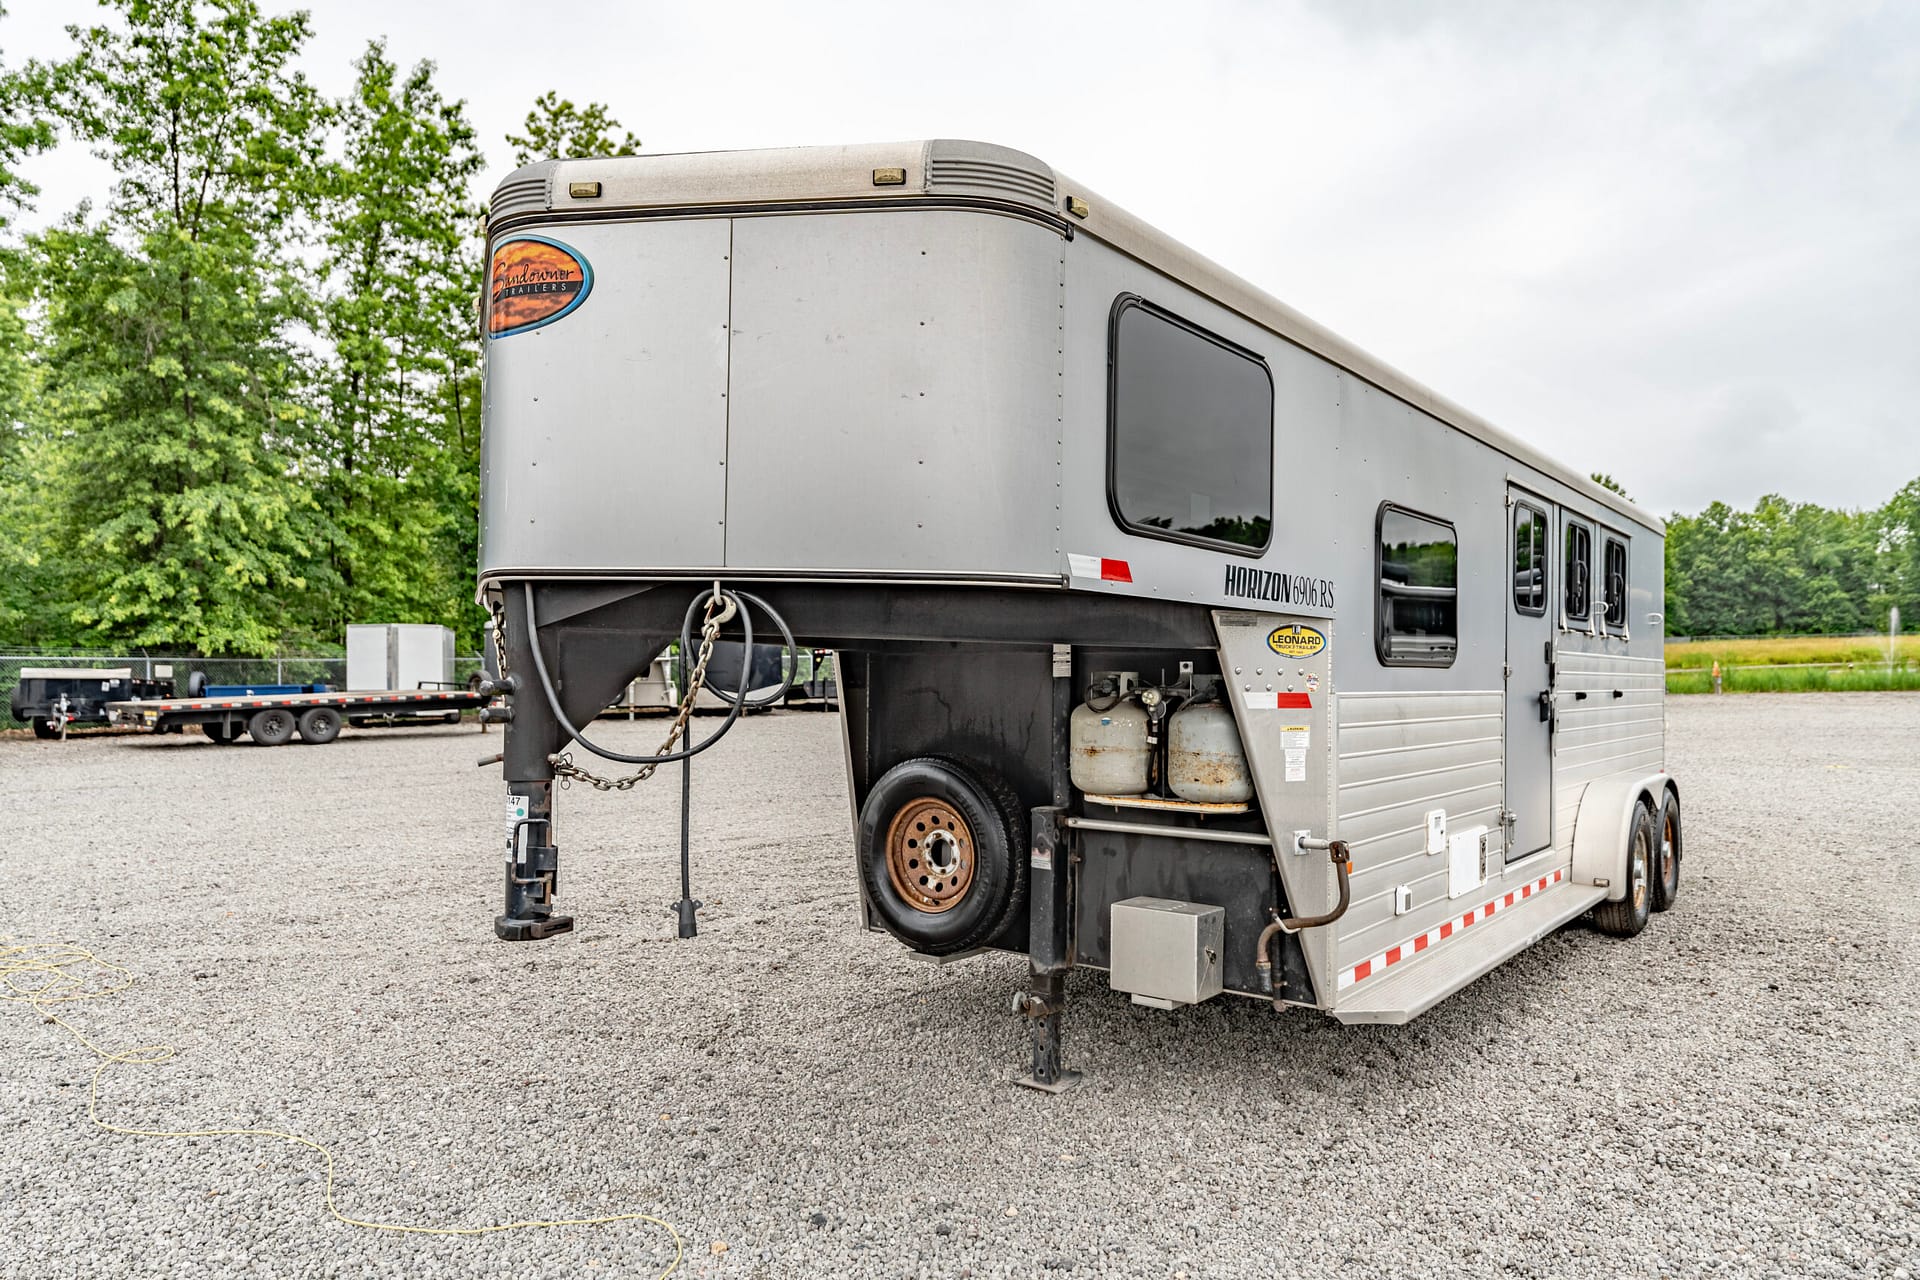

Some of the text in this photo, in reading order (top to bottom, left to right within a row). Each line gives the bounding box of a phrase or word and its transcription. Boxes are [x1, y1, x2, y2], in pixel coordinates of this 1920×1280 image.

[505, 283, 567, 297] TRAILERS
[1224, 564, 1334, 608] HORIZON 6906 RS
[1272, 635, 1321, 645] LEONARD
